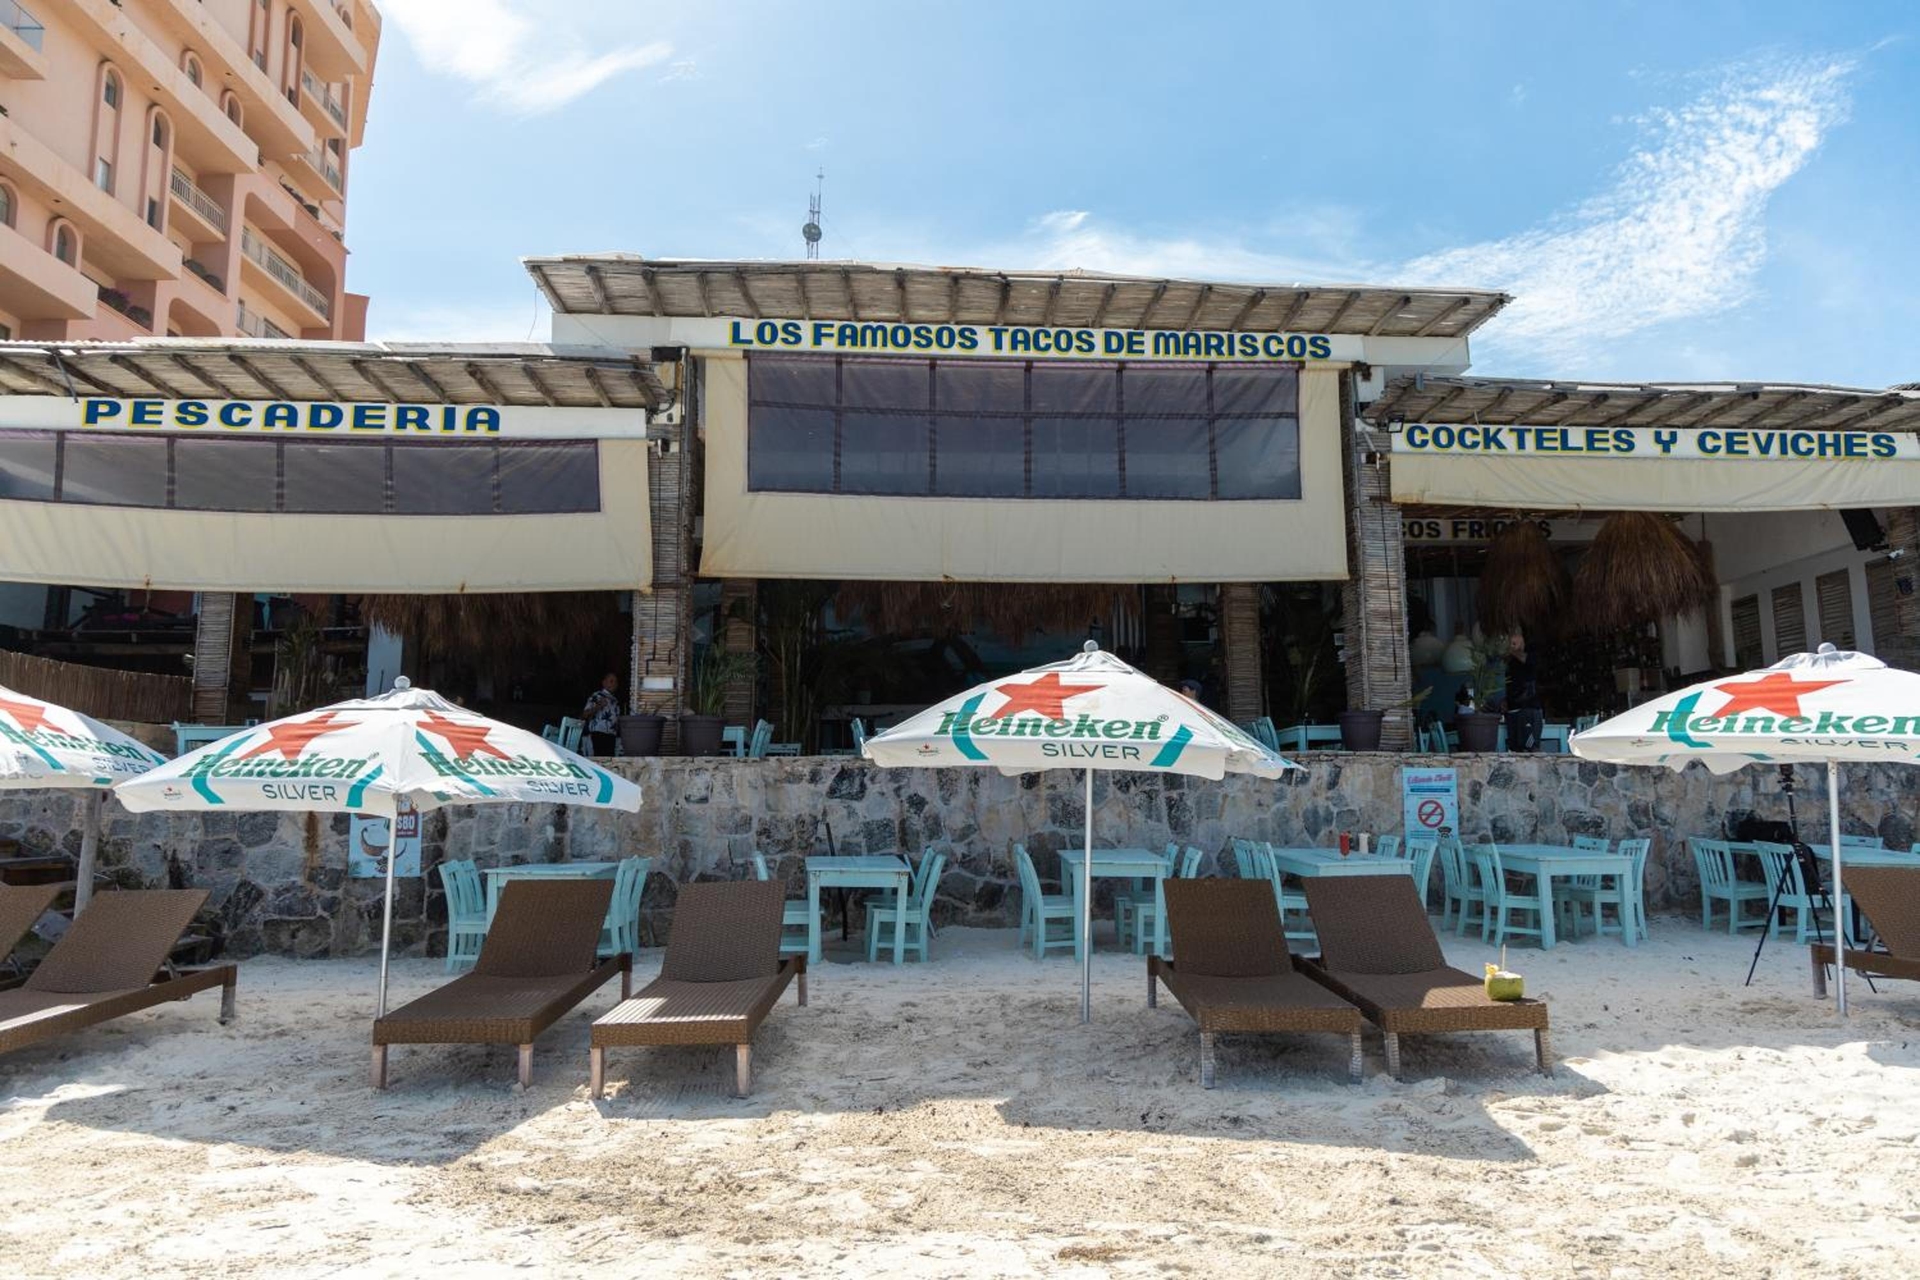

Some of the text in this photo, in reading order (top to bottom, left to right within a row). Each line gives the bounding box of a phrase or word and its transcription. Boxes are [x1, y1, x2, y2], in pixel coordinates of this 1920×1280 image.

[729, 321, 1331, 360] LOS FAMOSOS TACOS DE MARISCOS
[82, 400, 500, 434] PESCADERIA
[1406, 425, 1897, 458] COCKTELES Y CEVICHES
[934, 711, 1161, 740] Heineken
[1647, 711, 1920, 735] Heineken
[1042, 743, 1140, 760] SILVER
[178, 752, 368, 779] Heineken
[418, 752, 593, 779] Heineken
[262, 784, 337, 801] SILVER
[527, 780, 590, 797] SILVER
